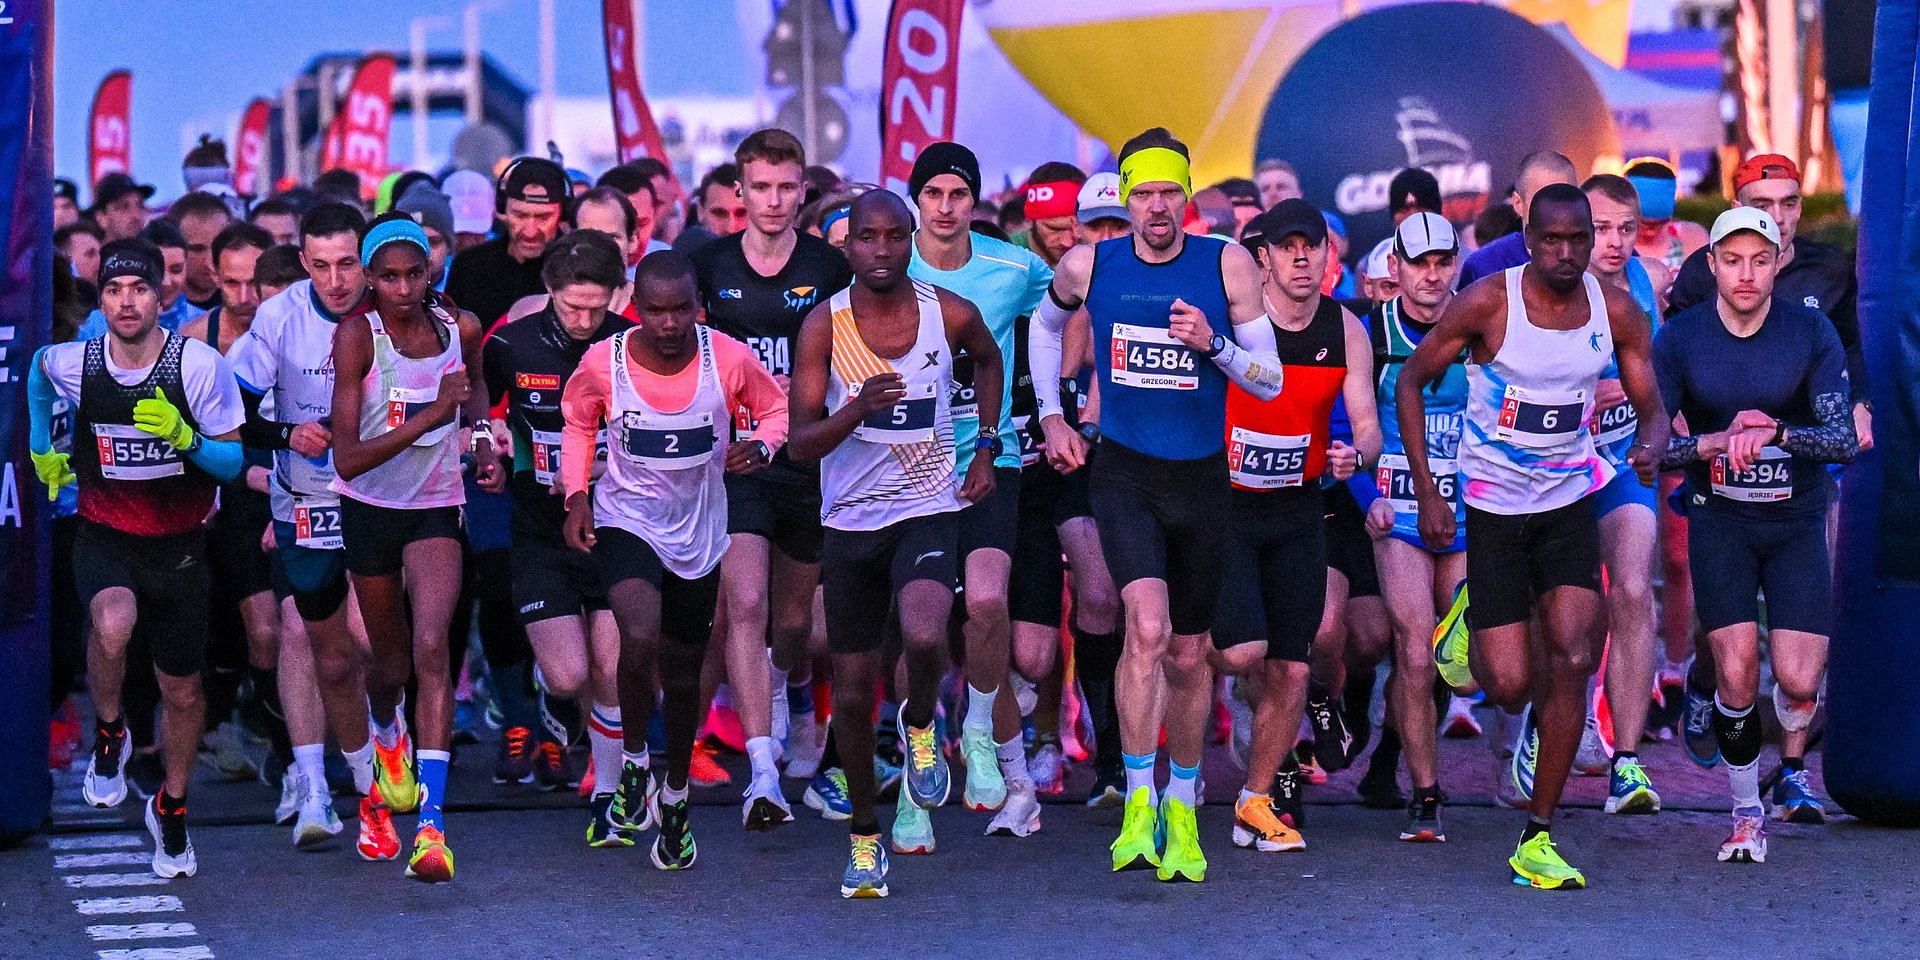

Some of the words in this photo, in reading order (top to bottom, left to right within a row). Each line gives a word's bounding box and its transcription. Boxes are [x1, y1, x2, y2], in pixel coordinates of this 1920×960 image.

[1115, 341, 1126, 351] A
[1117, 356, 1123, 366] 1
[1128, 346, 1195, 371] 4584
[531, 377, 557, 385] EXTRA
[1141, 377, 1177, 386] GRZEGORZ
[394, 403, 402, 411] A
[739, 404, 747, 414] A
[1507, 402, 1515, 411] A
[394, 415, 400, 424] 1
[891, 404, 908, 425] 5
[1542, 410, 1559, 429] 6
[741, 418, 746, 427] 1
[1505, 416, 1511, 425] 1
[102, 439, 109, 447] B
[665, 434, 679, 453] 2
[1233, 443, 1241, 453] A
[115, 441, 177, 462] 5542
[538, 444, 545, 453] A
[104, 453, 111, 462] 3
[1243, 450, 1304, 471] 4155
[1715, 458, 1723, 467] A
[539, 459, 545, 467] 1
[1232, 458, 1238, 468] 1
[1381, 469, 1390, 480] A
[1716, 472, 1721, 482] 1
[1395, 473, 1454, 498] 16
[300, 509, 307, 519] A
[311, 511, 341, 532] 22
[301, 525, 307, 535] 1
